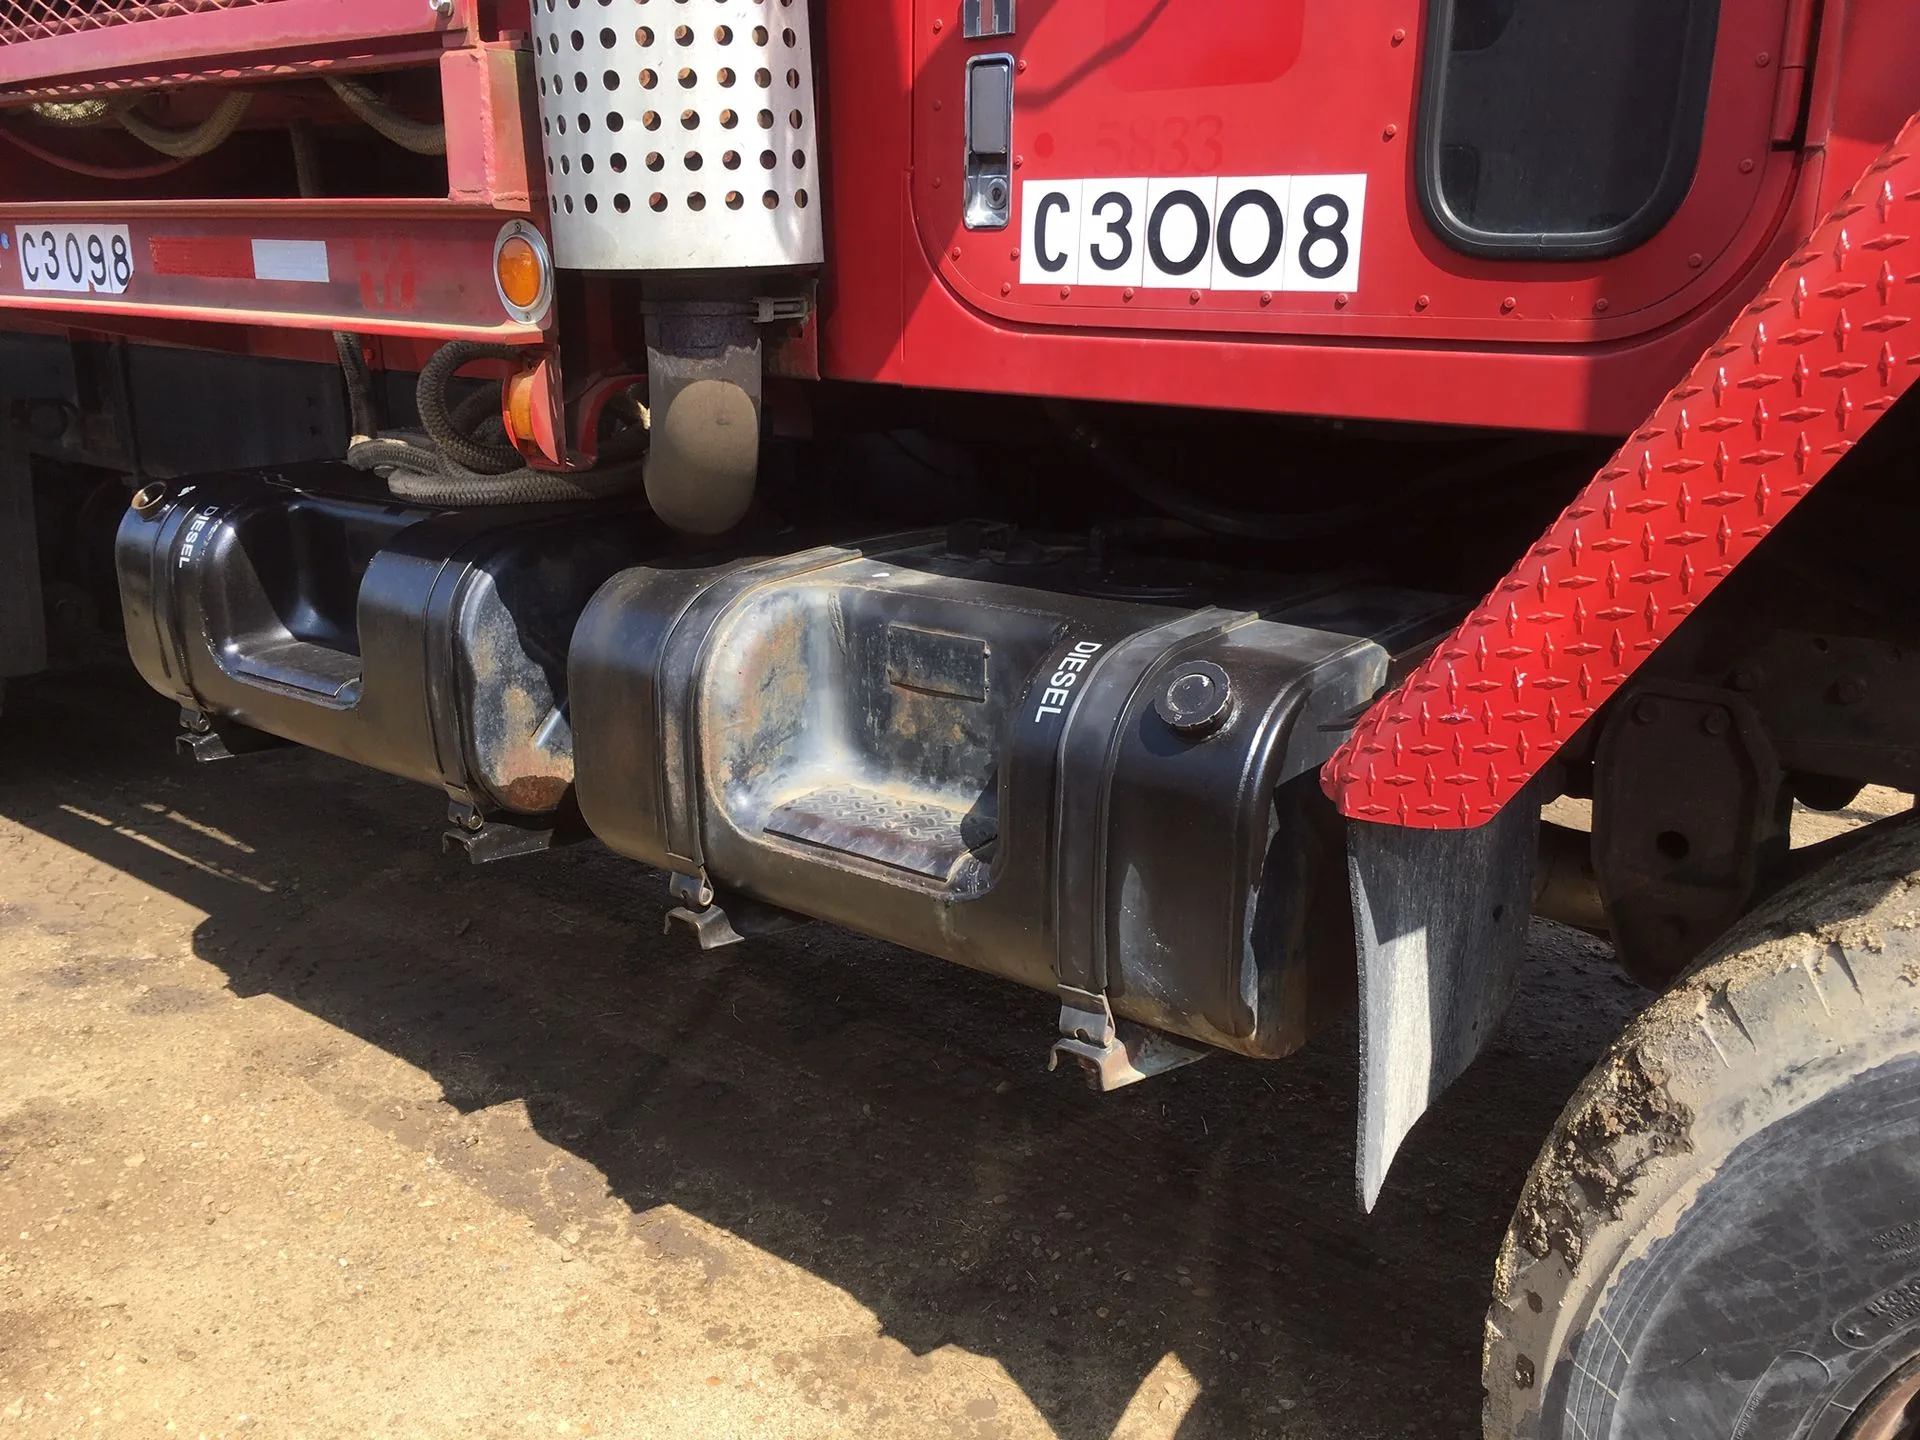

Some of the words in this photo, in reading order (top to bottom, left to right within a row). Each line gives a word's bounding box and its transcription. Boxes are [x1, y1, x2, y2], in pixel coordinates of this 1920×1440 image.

[1094, 113, 1224, 175] 5833
[22, 230, 130, 288] C3098
[1033, 188, 1350, 280] C3008
[178, 505, 220, 569] DIESEL
[1034, 641, 1103, 723] DIESEL
